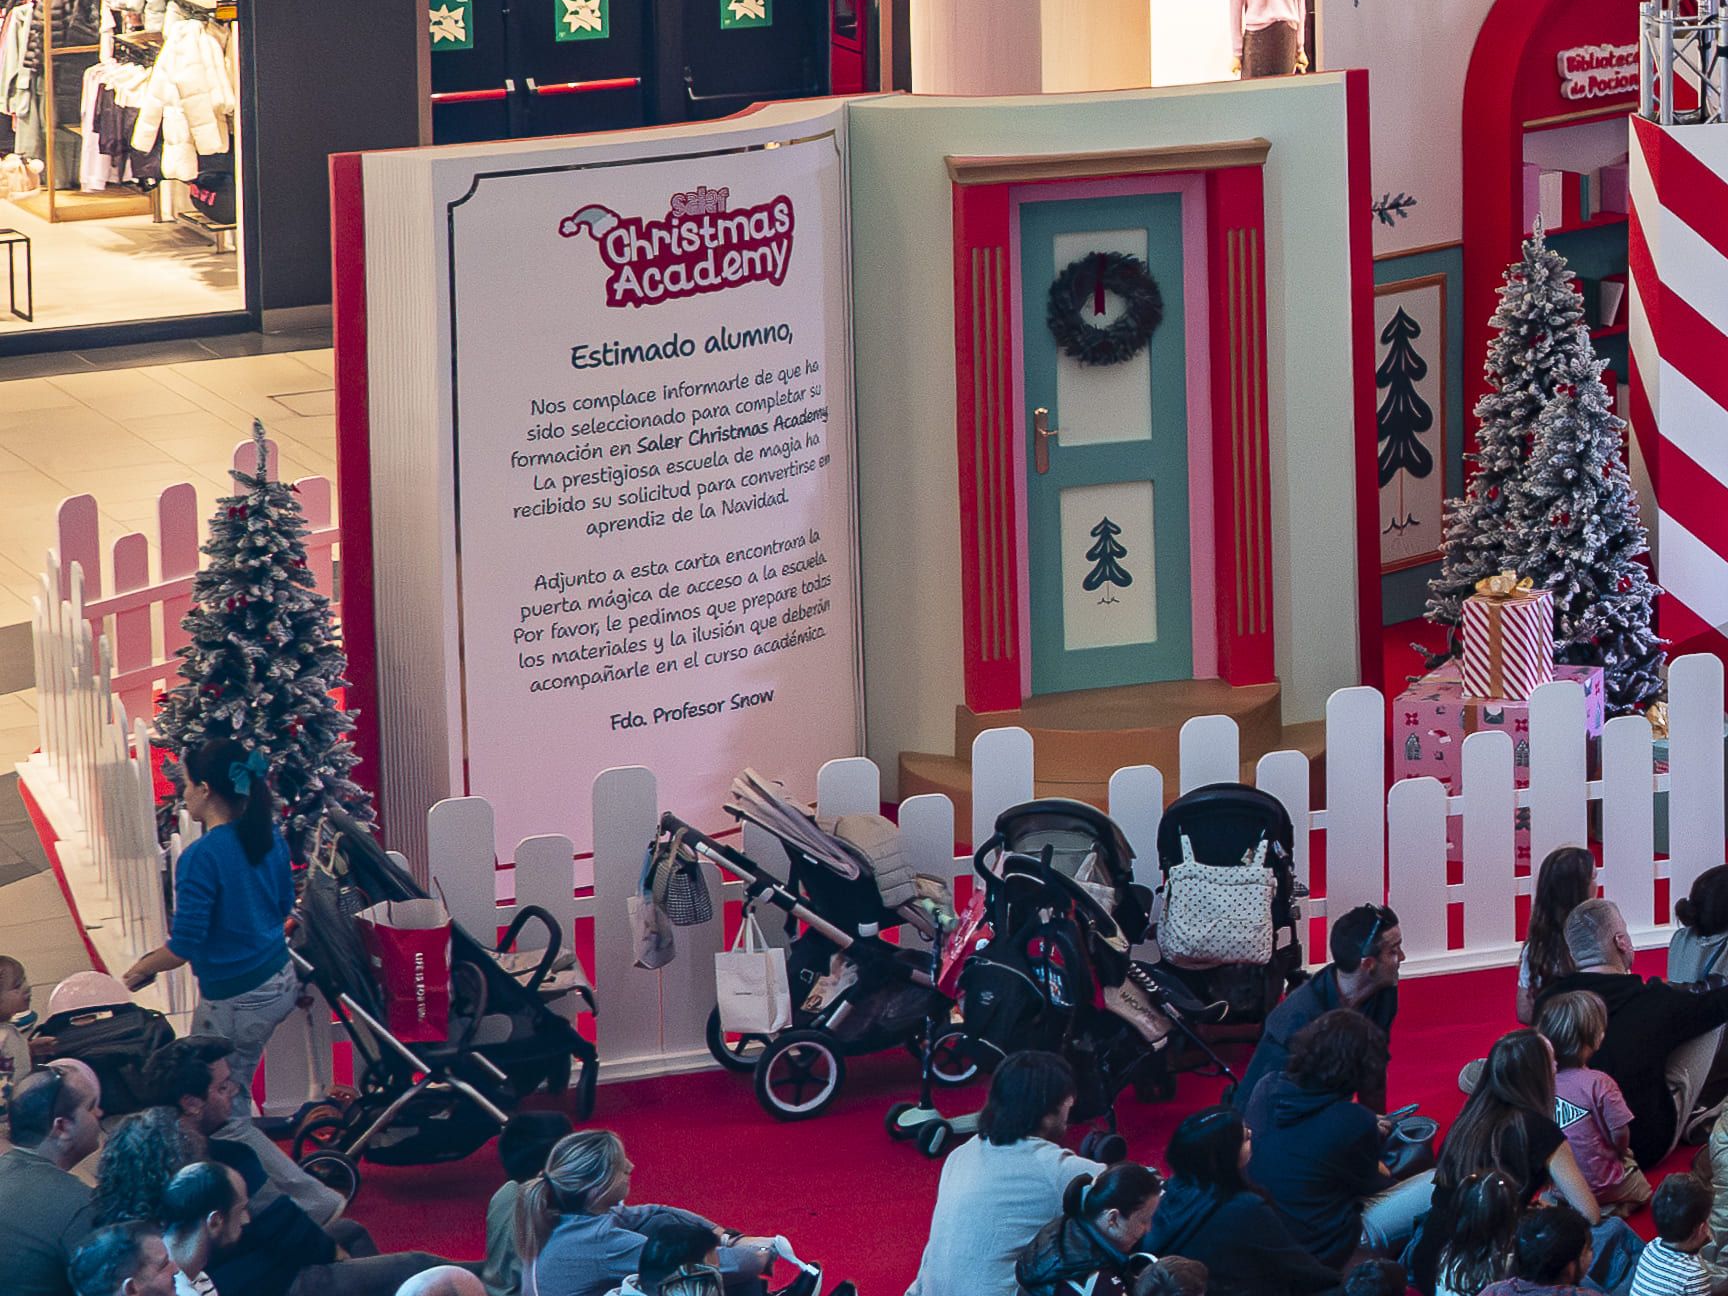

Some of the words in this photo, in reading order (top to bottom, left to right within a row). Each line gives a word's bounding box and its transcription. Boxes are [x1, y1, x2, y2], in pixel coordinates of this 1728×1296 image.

[671, 187, 729, 218] saler
[606, 202, 791, 265] Christmas
[613, 235, 788, 301] Academy
[571, 331, 696, 370] Estimado
[704, 320, 794, 354] alumno,
[527, 422, 565, 441] sido
[571, 408, 685, 436] seleccionado
[692, 405, 730, 430] para
[736, 389, 806, 413] completar
[810, 385, 821, 397] su
[531, 399, 566, 415] Nos
[573, 389, 656, 412] complace
[663, 373, 749, 400] informarle
[755, 369, 773, 385] de
[778, 366, 801, 385] que
[806, 359, 818, 374] ha
[511, 443, 603, 468] formación
[610, 444, 631, 456] en
[637, 434, 683, 453] Saler
[689, 422, 769, 446] Christmas
[534, 475, 556, 490] La
[562, 464, 660, 493] prestigiosa
[666, 451, 729, 474] escuela
[734, 447, 753, 463] de
[760, 437, 802, 463] magia
[806, 432, 819, 447] ha
[513, 496, 585, 518] recibido
[593, 496, 611, 509] su
[618, 480, 691, 505] solicitud
[697, 479, 736, 500] para
[741, 460, 815, 487] convertirse
[819, 454, 830, 468] en
[586, 511, 665, 538] aprendiz
[672, 506, 693, 523] de
[700, 503, 716, 518] la
[722, 488, 789, 515] Navidad.
[534, 569, 606, 593] Adjunto
[613, 569, 625, 581] a
[631, 561, 669, 578] esta
[675, 553, 720, 571] carta
[809, 528, 820, 544] la
[514, 628, 544, 644] Por
[552, 622, 599, 639] favor,
[607, 615, 622, 631] le
[629, 607, 702, 638] pedimos
[707, 601, 736, 624] que
[742, 587, 797, 614] prepare
[521, 597, 581, 623] puerta
[588, 588, 652, 610] mágica
[659, 582, 680, 598] de
[687, 575, 742, 594] acceso
[748, 572, 758, 584] a
[763, 565, 777, 580] la
[519, 653, 544, 668] los
[552, 638, 647, 668] materiales
[654, 638, 664, 654] y
[671, 631, 687, 646] la
[693, 620, 745, 643] ilusión
[750, 616, 777, 635] que
[782, 599, 830, 624] deberán
[530, 657, 650, 692] acompañarle
[656, 660, 678, 673] en
[684, 651, 699, 669] el
[705, 648, 748, 665] curso
[653, 700, 725, 724] Profesor
[730, 690, 774, 710] Snow
